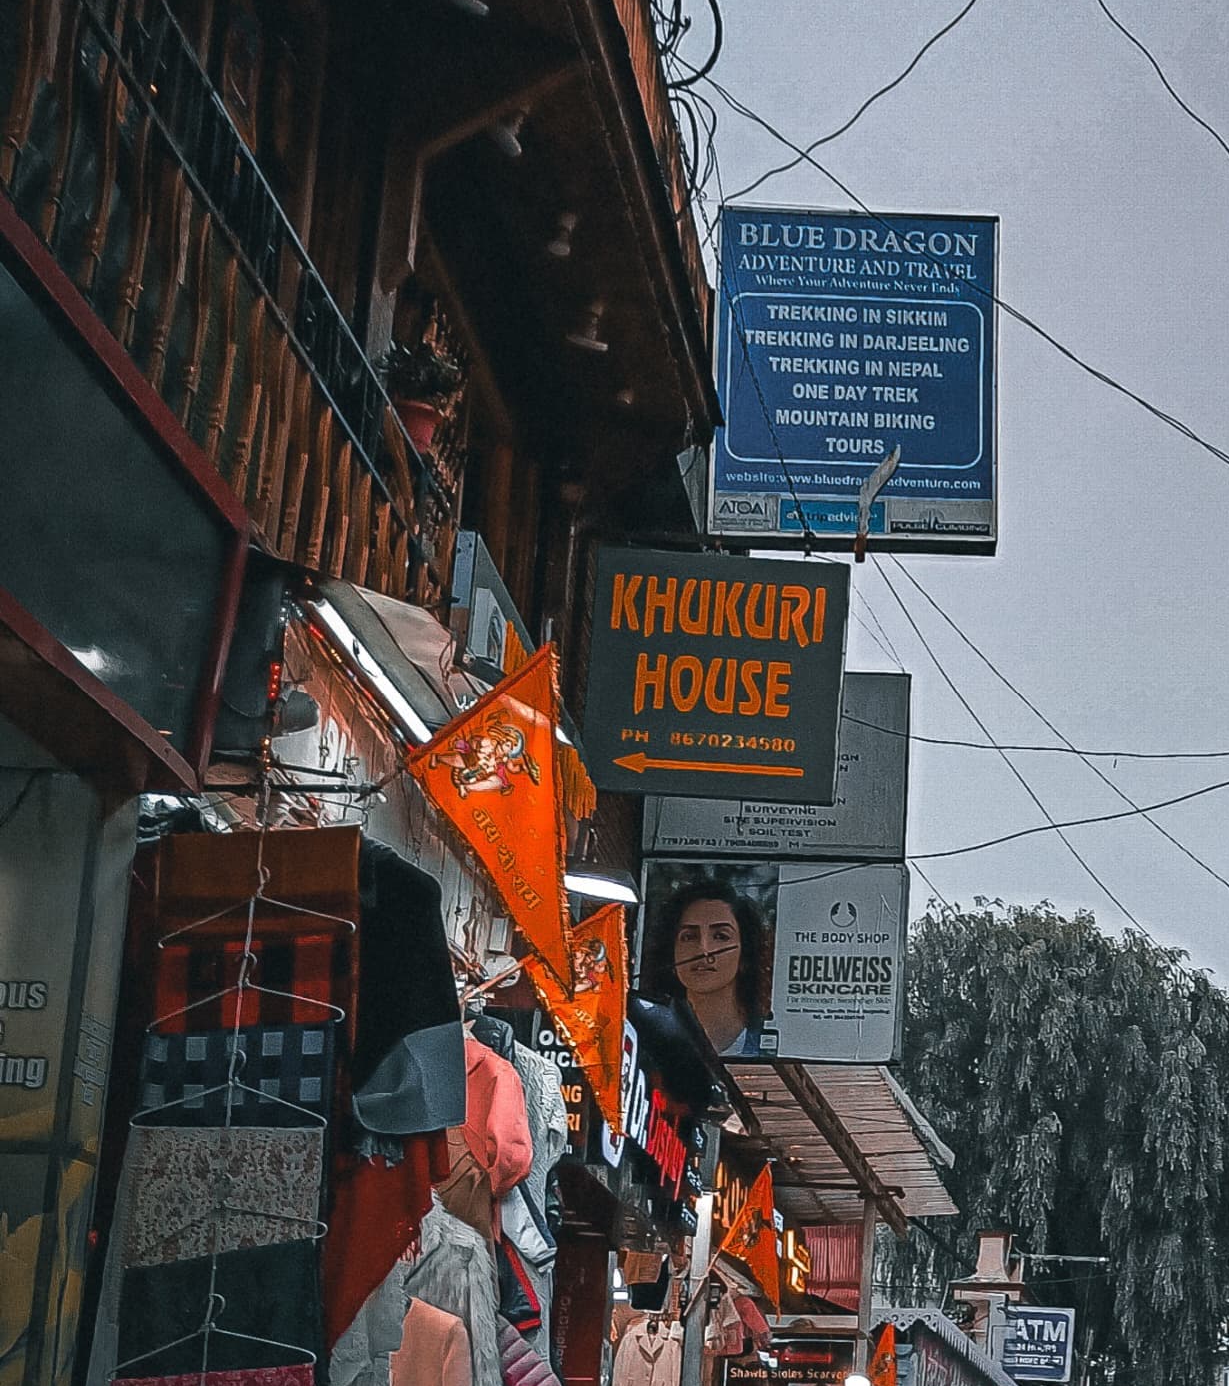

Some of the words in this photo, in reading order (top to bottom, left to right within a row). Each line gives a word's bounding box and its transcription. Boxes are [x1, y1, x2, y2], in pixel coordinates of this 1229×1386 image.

[739, 222, 826, 249] BLUE
[835, 227, 978, 258] DRAGON
[738, 254, 856, 275] ADVENTURE
[858, 260, 900, 277] AND
[904, 262, 977, 281] TRAVEL
[755, 274, 797, 287] Where
[798, 275, 828, 288] Your
[830, 277, 891, 291] Adventure
[893, 280, 928, 293] Never
[931, 282, 961, 296] Ends
[766, 305, 858, 323] TREKKING
[863, 307, 882, 323] IN
[886, 309, 948, 327] SIKKIM
[744, 329, 834, 349] TREKKING
[839, 332, 858, 348] IN
[862, 333, 970, 353] DARJEELING
[769, 357, 860, 376] TREKKING
[865, 360, 884, 377] IN
[888, 361, 944, 379] NEPAL
[792, 383, 829, 400] ONE
[834, 385, 869, 402] DAY
[872, 386, 920, 403] TREK
[775, 409, 869, 428] MOUNTAIN
[873, 412, 936, 430] BIKING
[825, 437, 885, 455] TOURS
[610, 573, 826, 648] KHUKURI
[634, 652, 792, 718] HOUSE
[620, 729, 649, 743] PH
[669, 731, 796, 752] 8670234580
[744, 804, 817, 816] SURVEYING
[723, 815, 750, 826] SITE
[752, 816, 837, 828] SUPERVISION
[748, 827, 778, 838] SOIL
[780, 828, 811, 838] TEST
[794, 931, 818, 944] THE
[821, 932, 854, 944] BODY
[856, 933, 890, 945] SHOP
[788, 954, 893, 984] EDELWEISS
[787, 983, 892, 996] SKINCARE
[1016, 1318, 1067, 1342] ATM
[730, 1367, 768, 1379] Shawls
